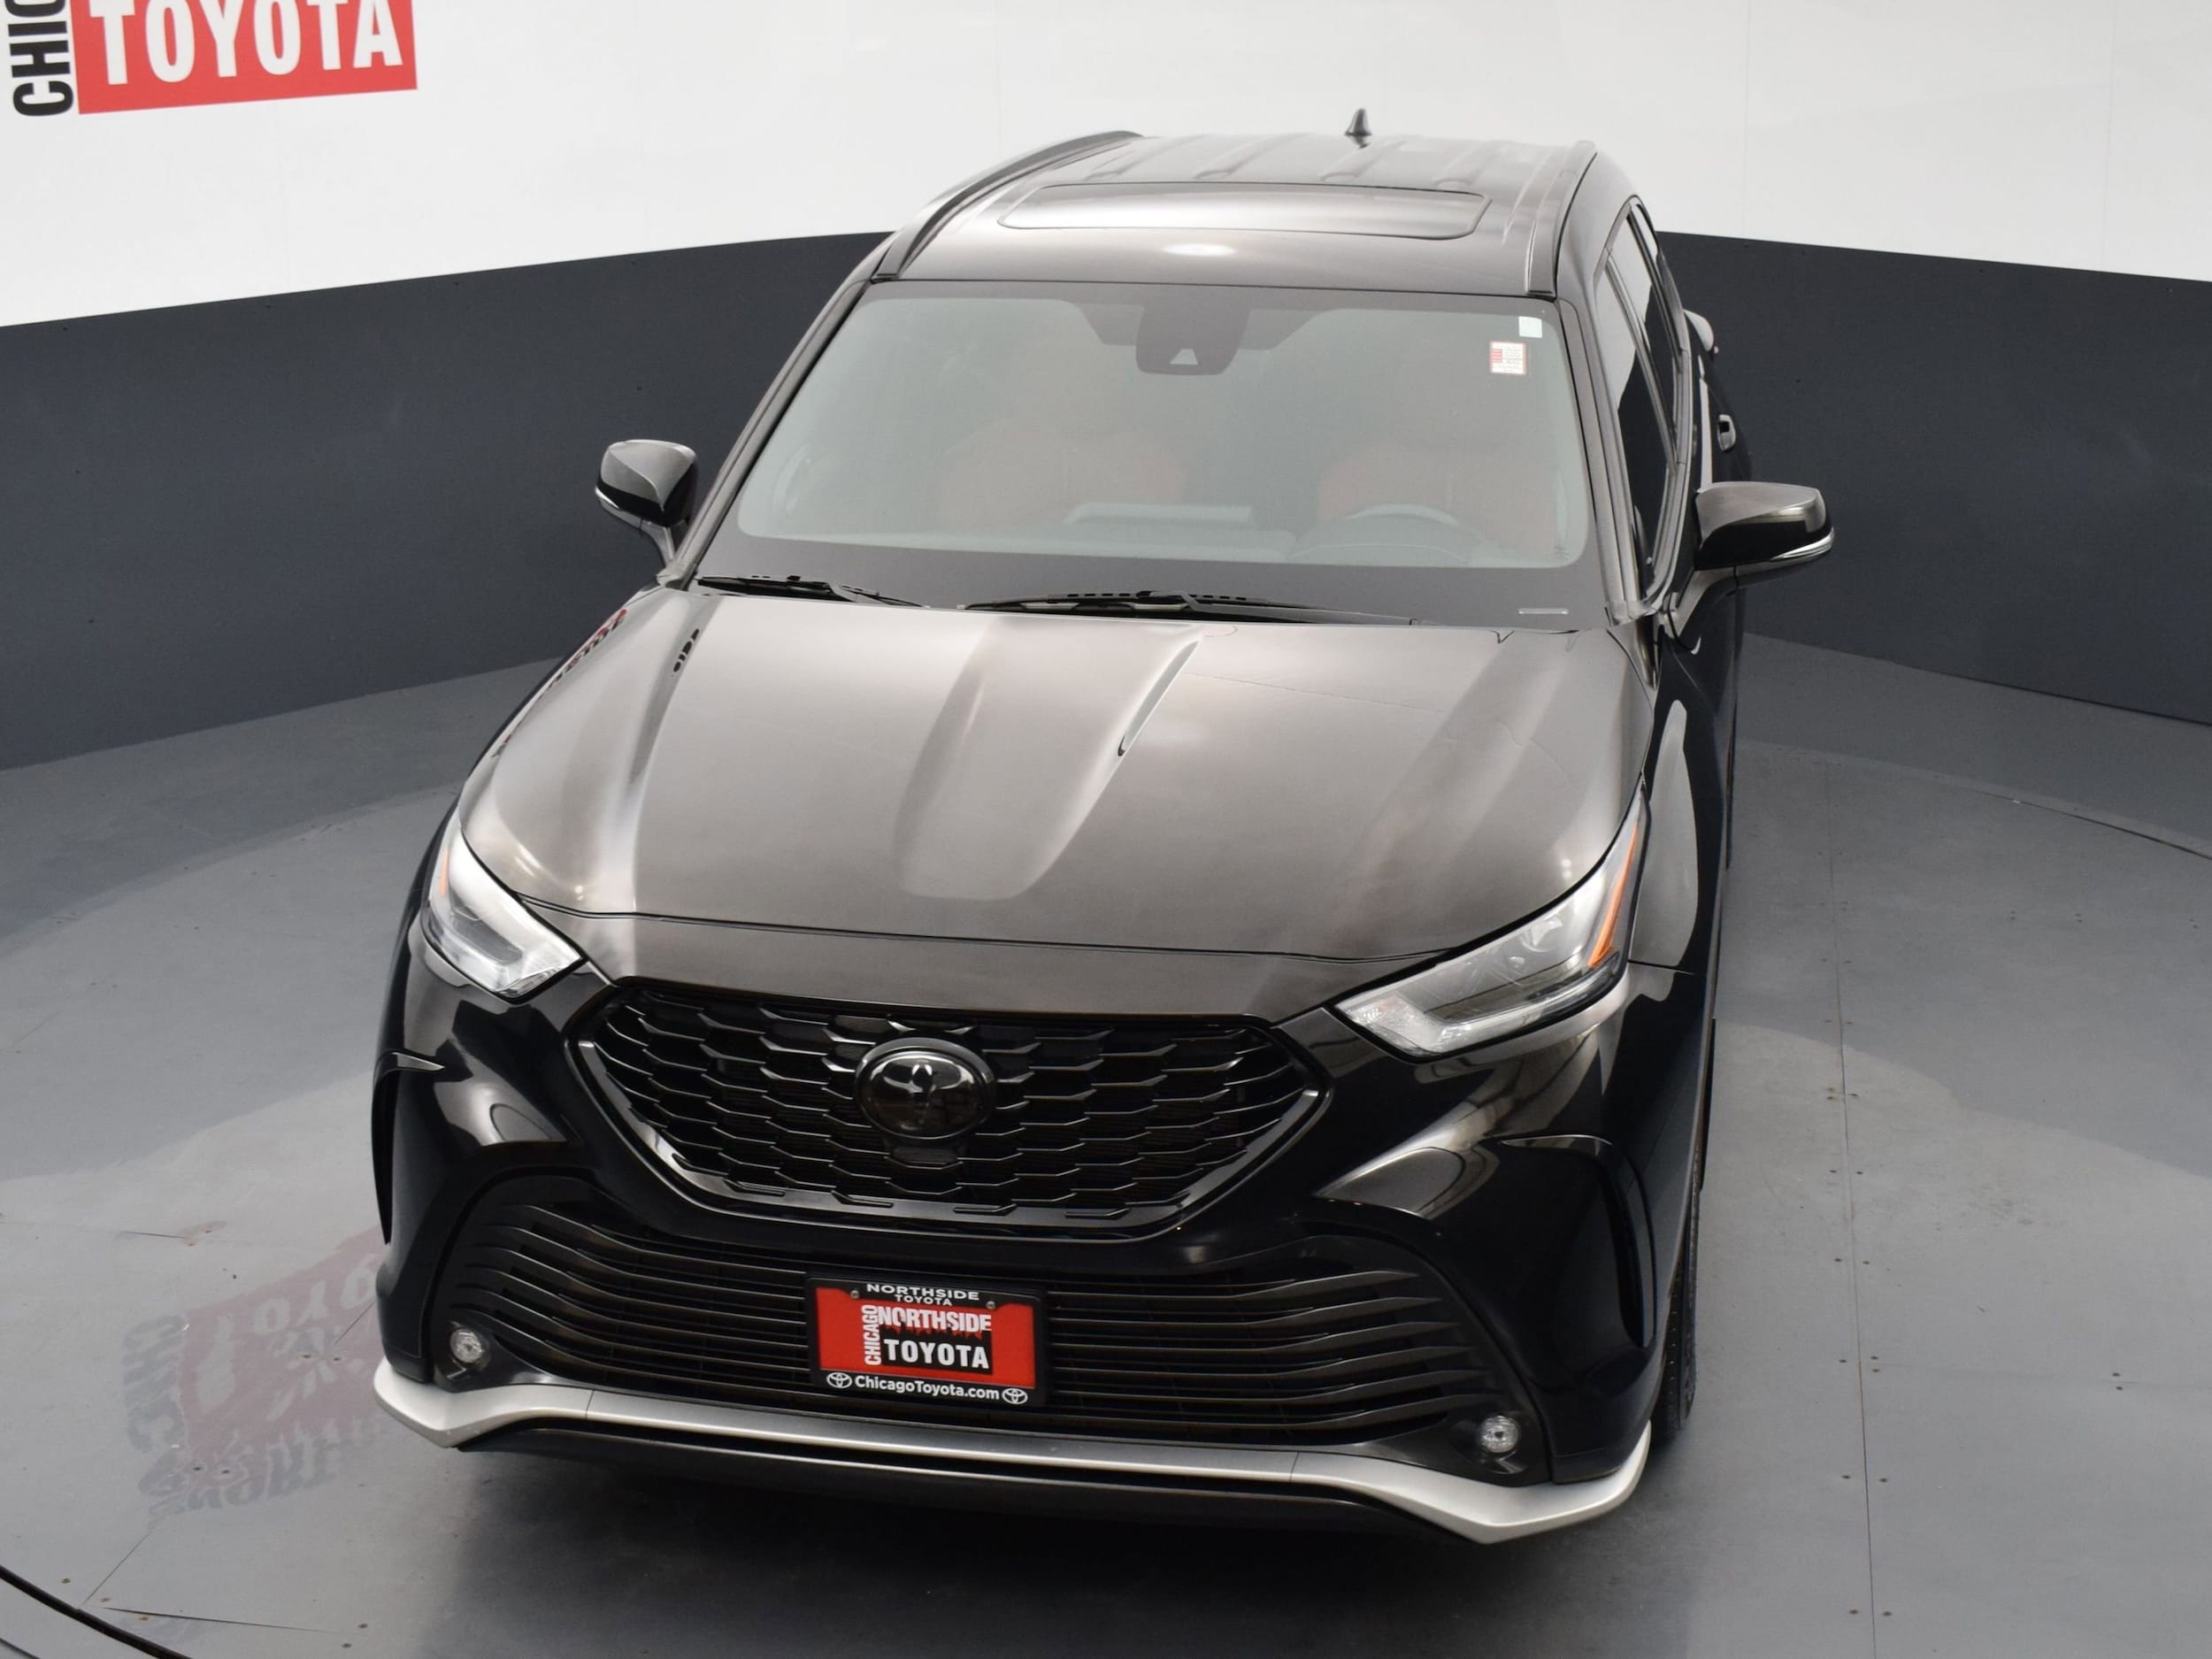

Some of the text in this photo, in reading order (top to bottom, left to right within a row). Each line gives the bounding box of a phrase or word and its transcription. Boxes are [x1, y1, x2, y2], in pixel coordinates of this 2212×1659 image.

[89, 0, 403, 85] TOYOTA
[867, 1284, 979, 1301] NORTHSIDE
[895, 1294, 952, 1306] TOYOTA
[878, 1306, 992, 1333] NORTHSIDE
[861, 1304, 881, 1365] CHICAGO
[883, 1339, 989, 1369] TOYOTA
[855, 1376, 1000, 1400] ChicagoToyota.com
